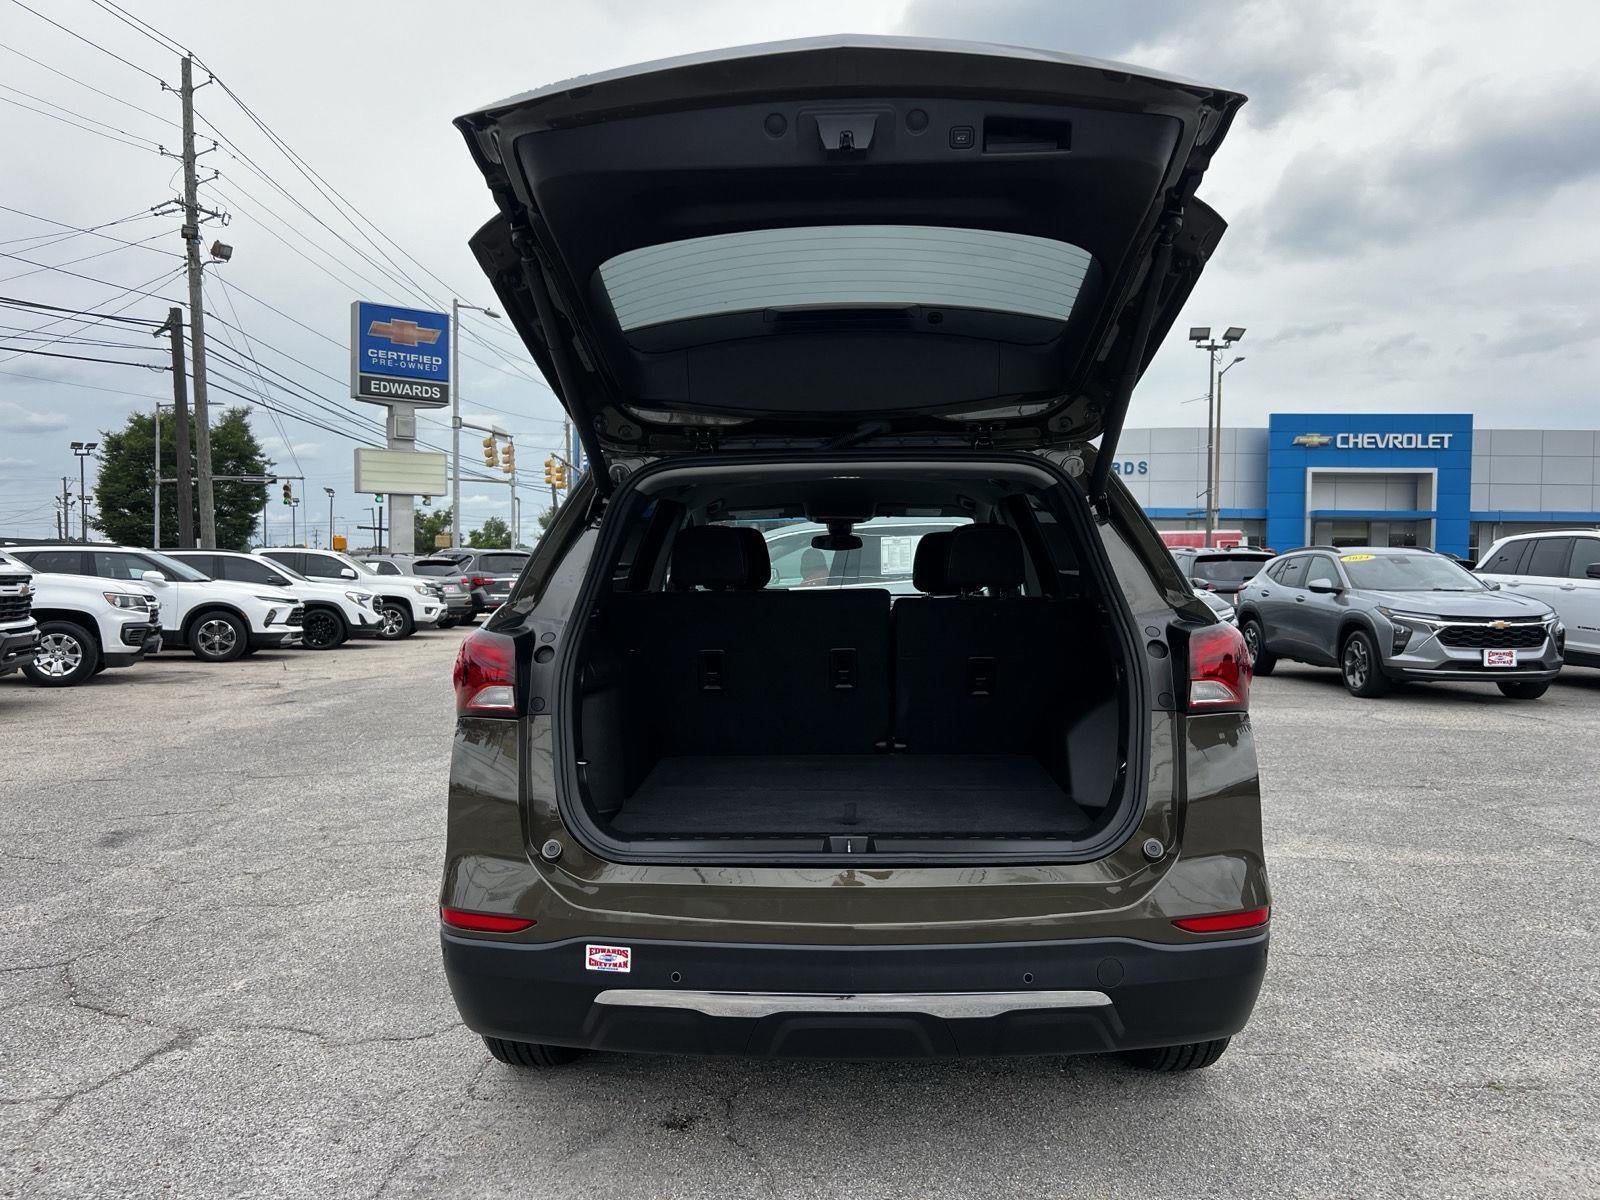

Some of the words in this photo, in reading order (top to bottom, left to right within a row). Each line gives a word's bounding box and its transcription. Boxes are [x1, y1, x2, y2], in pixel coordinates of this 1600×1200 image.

[368, 349, 442, 365] CERTIFIED
[372, 357, 438, 372] PRE-OWNED
[370, 381, 441, 398] EDWARDS
[1336, 433, 1452, 449] CHEVROLET
[589, 947, 629, 959] EDWARDS
[588, 957, 629, 969] CHEVYMAN
